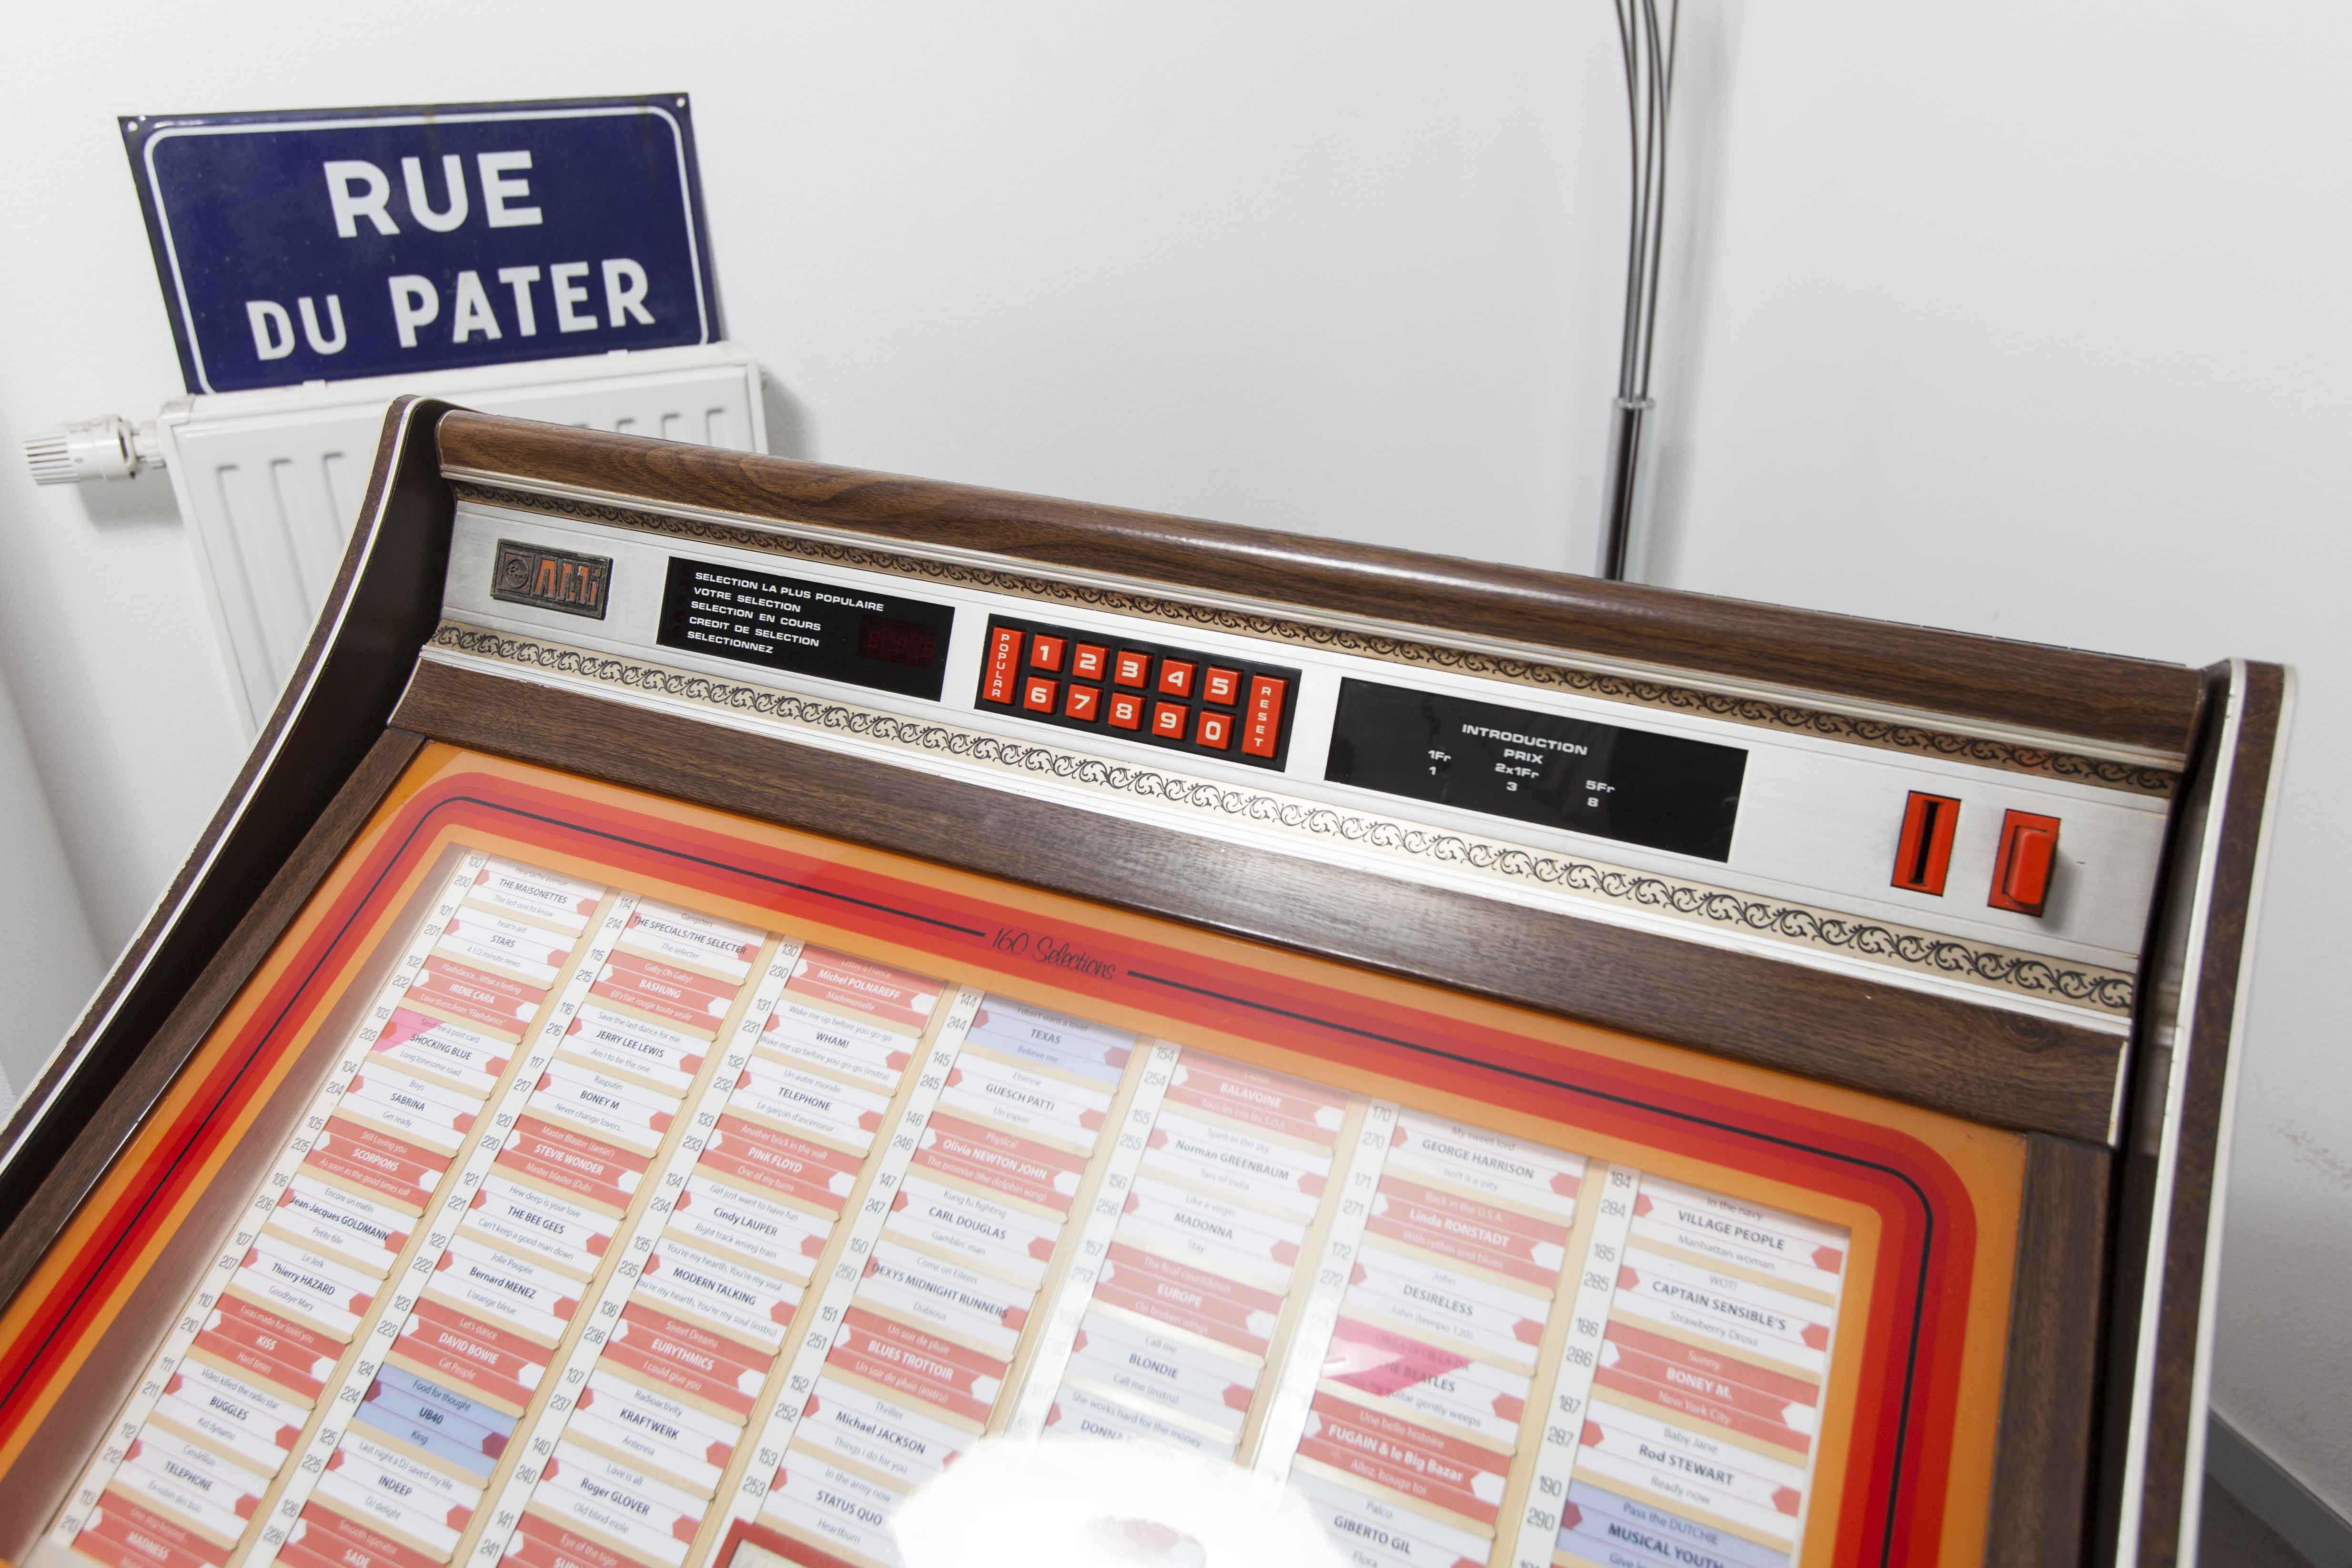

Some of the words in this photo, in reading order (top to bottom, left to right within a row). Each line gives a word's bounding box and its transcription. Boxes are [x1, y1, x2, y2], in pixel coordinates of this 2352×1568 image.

[323, 150, 544, 239] RUE
[245, 294, 347, 361] DU
[388, 257, 656, 349] PATER
[694, 587, 732, 600] VOTRE
[737, 595, 801, 613] SELECTION
[696, 572, 758, 589] SELECTION
[762, 584, 777, 593] LA
[780, 587, 811, 599] PLUS
[816, 593, 884, 612] POPULAIRE
[691, 601, 753, 618] SELECTION
[759, 613, 776, 623] EN
[780, 617, 821, 631] COURS
[687, 631, 773, 654] SELECTIONNEZ
[689, 617, 729, 630] CREDIT
[734, 625, 749, 634] DE
[755, 628, 819, 647] SELECTION
[991, 634, 1009, 698] POPULAR
[1040, 645, 1049, 661] 1
[1080, 653, 1097, 670] 2
[1122, 661, 1138, 678] 3
[1168, 671, 1184, 687] 4
[1211, 678, 1228, 696] 5
[1030, 688, 1047, 704] 6
[1075, 696, 1090, 710] 7
[1116, 703, 1132, 720] 8
[1160, 712, 1177, 728] 9
[1206, 721, 1221, 739] 0
[1254, 687, 1271, 747] RESET
[1462, 724, 1587, 755] INTRODUCTION
[1428, 750, 1452, 761] 1Fr
[1504, 749, 1543, 764] PRIX
[1429, 767, 1436, 775] 1
[1495, 763, 1539, 779] 2x1Fr
[1506, 782, 1517, 791] 3
[1586, 780, 1615, 793] 5Fr
[1587, 798, 1599, 807] 8
[468, 856, 482, 869] 100
[499, 879, 515, 889] THE
[516, 883, 568, 904] MAISONETTES
[490, 935, 515, 948] STARS
[633, 916, 648, 927] THE
[649, 921, 707, 947] SPECIALS/THE
[707, 936, 747, 955] SELECTER
[781, 943, 798, 956] 130
[992, 928, 1029, 954] 160
[1032, 937, 1116, 980] Selections
[450, 983, 472, 996] IRENE
[472, 989, 495, 1004] CARA
[639, 979, 682, 999] BASHUNG
[818, 969, 848, 985] Michel
[848, 977, 901, 1000] POLNAREFF
[376, 1007, 390, 1019] 103
[420, 1018, 436, 1031] Send
[438, 1024, 447, 1034] me
[453, 1029, 466, 1041] post
[467, 1032, 480, 1044] card
[545, 1023, 563, 1036] 216
[1030, 1029, 1062, 1044] TEXAS
[410, 1033, 450, 1053] SHOCKING
[451, 1047, 473, 1060] BLUE
[596, 1030, 623, 1045] JERRY
[623, 1038, 638, 1048] LEE
[638, 1042, 665, 1058] LEWIS
[409, 1080, 425, 1091] Boys
[594, 1075, 623, 1091] Rasputin
[713, 1076, 734, 1093] 232
[986, 1083, 1027, 1102] GUESCH
[1027, 1094, 1055, 1111] PATTI
[1220, 1081, 1282, 1109] BALAVOINE
[390, 1093, 425, 1112] SABRINA
[580, 1091, 609, 1106] BONEY
[610, 1101, 620, 1110] M
[778, 1087, 832, 1111] TELEPHONE
[353, 1148, 400, 1172] SCORPIONS
[534, 1143, 564, 1161] STEVIE
[564, 1154, 605, 1175] WONDER
[748, 1147, 772, 1162] PINK
[771, 1154, 803, 1173] FLOYD
[943, 1139, 972, 1156] Olivia
[972, 1149, 1020, 1170] NEWTON
[1019, 1162, 1048, 1181] JOHN
[1176, 1140, 1218, 1160] Norman
[1220, 1150, 1289, 1181] GREENBAUM
[1423, 1139, 1471, 1161] GEORGE
[1472, 1154, 1534, 1179] HARRISON
[1610, 1171, 1631, 1189] 184
[290, 1196, 340, 1223] Jean-Jacques
[341, 1215, 390, 1242] GOLDMANN
[507, 1205, 524, 1219] THE
[525, 1211, 543, 1225] BEE
[544, 1217, 565, 1234] GEES
[714, 1208, 740, 1224] Cindy
[740, 1216, 778, 1236] LAUPER
[929, 1207, 957, 1224] CARL
[957, 1216, 1007, 1240] DOUGLAS
[1174, 1213, 1233, 1240] MADONNA
[1409, 1208, 1443, 1228] Linda
[1444, 1219, 1510, 1248] RONSTADT
[1678, 1210, 1731, 1235] VILLAGE
[1734, 1226, 1785, 1251] PEOPLE
[272, 1262, 300, 1284] Thierry
[300, 1275, 335, 1296] HAZARD
[469, 1266, 505, 1287] Bernard
[505, 1280, 537, 1299] MENEZ
[673, 1268, 715, 1290] MODERN
[716, 1283, 756, 1305] TALKING
[871, 1263, 904, 1282] DEXYS
[905, 1276, 958, 1300] MIDNIGHT
[958, 1294, 1009, 1319] RUNNERS
[1157, 1284, 1202, 1308] EUROPE
[1403, 1285, 1474, 1316] DESIRELESS
[1652, 1281, 1709, 1307] CAPTAIN
[1711, 1297, 1787, 1331] SENSIBLE'S
[257, 1335, 277, 1350] KISS
[438, 1333, 469, 1350] DAVID
[468, 1346, 499, 1364] BOWIE
[651, 1338, 714, 1370] EURYTHMICS
[867, 1340, 901, 1360] BLUES
[902, 1352, 954, 1381] TROTTOIR
[1129, 1353, 1179, 1379] BLONDIE
[1403, 1365, 1455, 1393] BEATLES
[1666, 1366, 1713, 1393] BONEY
[1715, 1383, 1733, 1400] M.
[210, 1396, 249, 1421] BUGGLES
[419, 1407, 444, 1425] UB40
[634, 1390, 683, 1418] Radioactivity
[411, 1429, 429, 1445] King
[619, 1407, 679, 1440] KRAFTWERK
[836, 1411, 877, 1434] Michael
[877, 1427, 927, 1455] JACKSON
[622, 1436, 655, 1456] Antenna
[1328, 1424, 1379, 1453] FUGAIN
[1379, 1442, 1389, 1456] &
[1390, 1445, 1403, 1461] le
[1404, 1452, 1425, 1472] Big
[1427, 1459, 1463, 1482] Bazar
[165, 1460, 213, 1492] TELEPHONE
[1639, 1444, 1665, 1462] Rod
[1668, 1454, 1733, 1486] STEWART
[378, 1475, 412, 1497] INDEEP
[580, 1477, 610, 1497] Roger
[610, 1490, 650, 1516] GLOVER
[816, 1490, 855, 1514] STATUS
[857, 1509, 883, 1526] QUO
[127, 1531, 172, 1559] MADNESS
[1334, 1516, 1390, 1544] GIBERTO
[1391, 1535, 1411, 1554] GIL
[1608, 1523, 1671, 1556] MUSICAL
[344, 1549, 371, 1568] SADE
